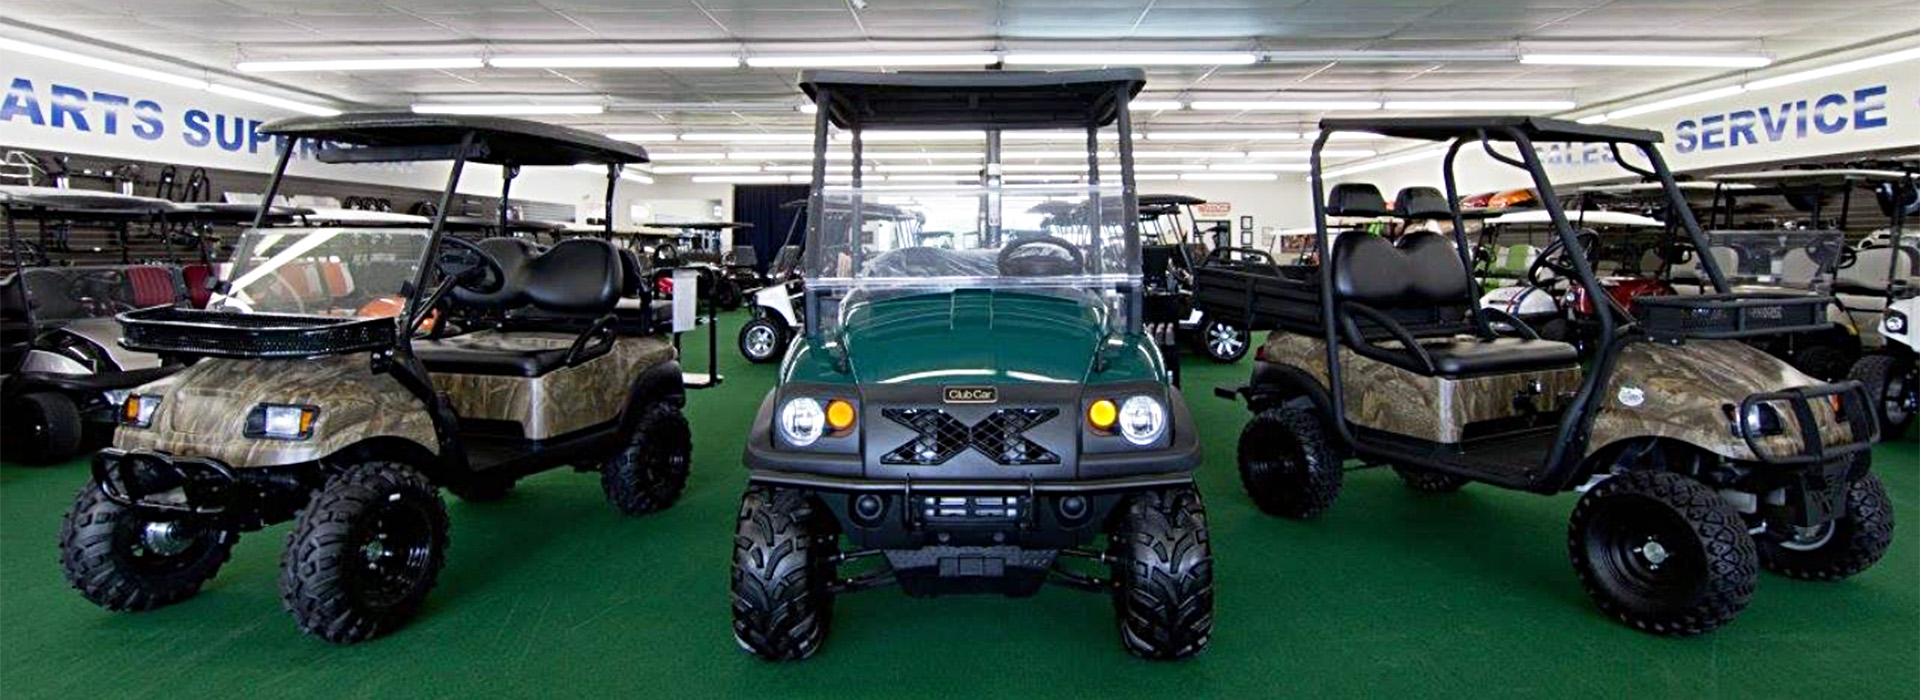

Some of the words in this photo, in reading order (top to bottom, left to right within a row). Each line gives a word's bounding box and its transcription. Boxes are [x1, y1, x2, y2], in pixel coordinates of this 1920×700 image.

[0, 77, 165, 141] ARTS
[1675, 85, 1888, 154] SERVICE
[948, 389, 972, 399] Club
[973, 389, 992, 399] Car
